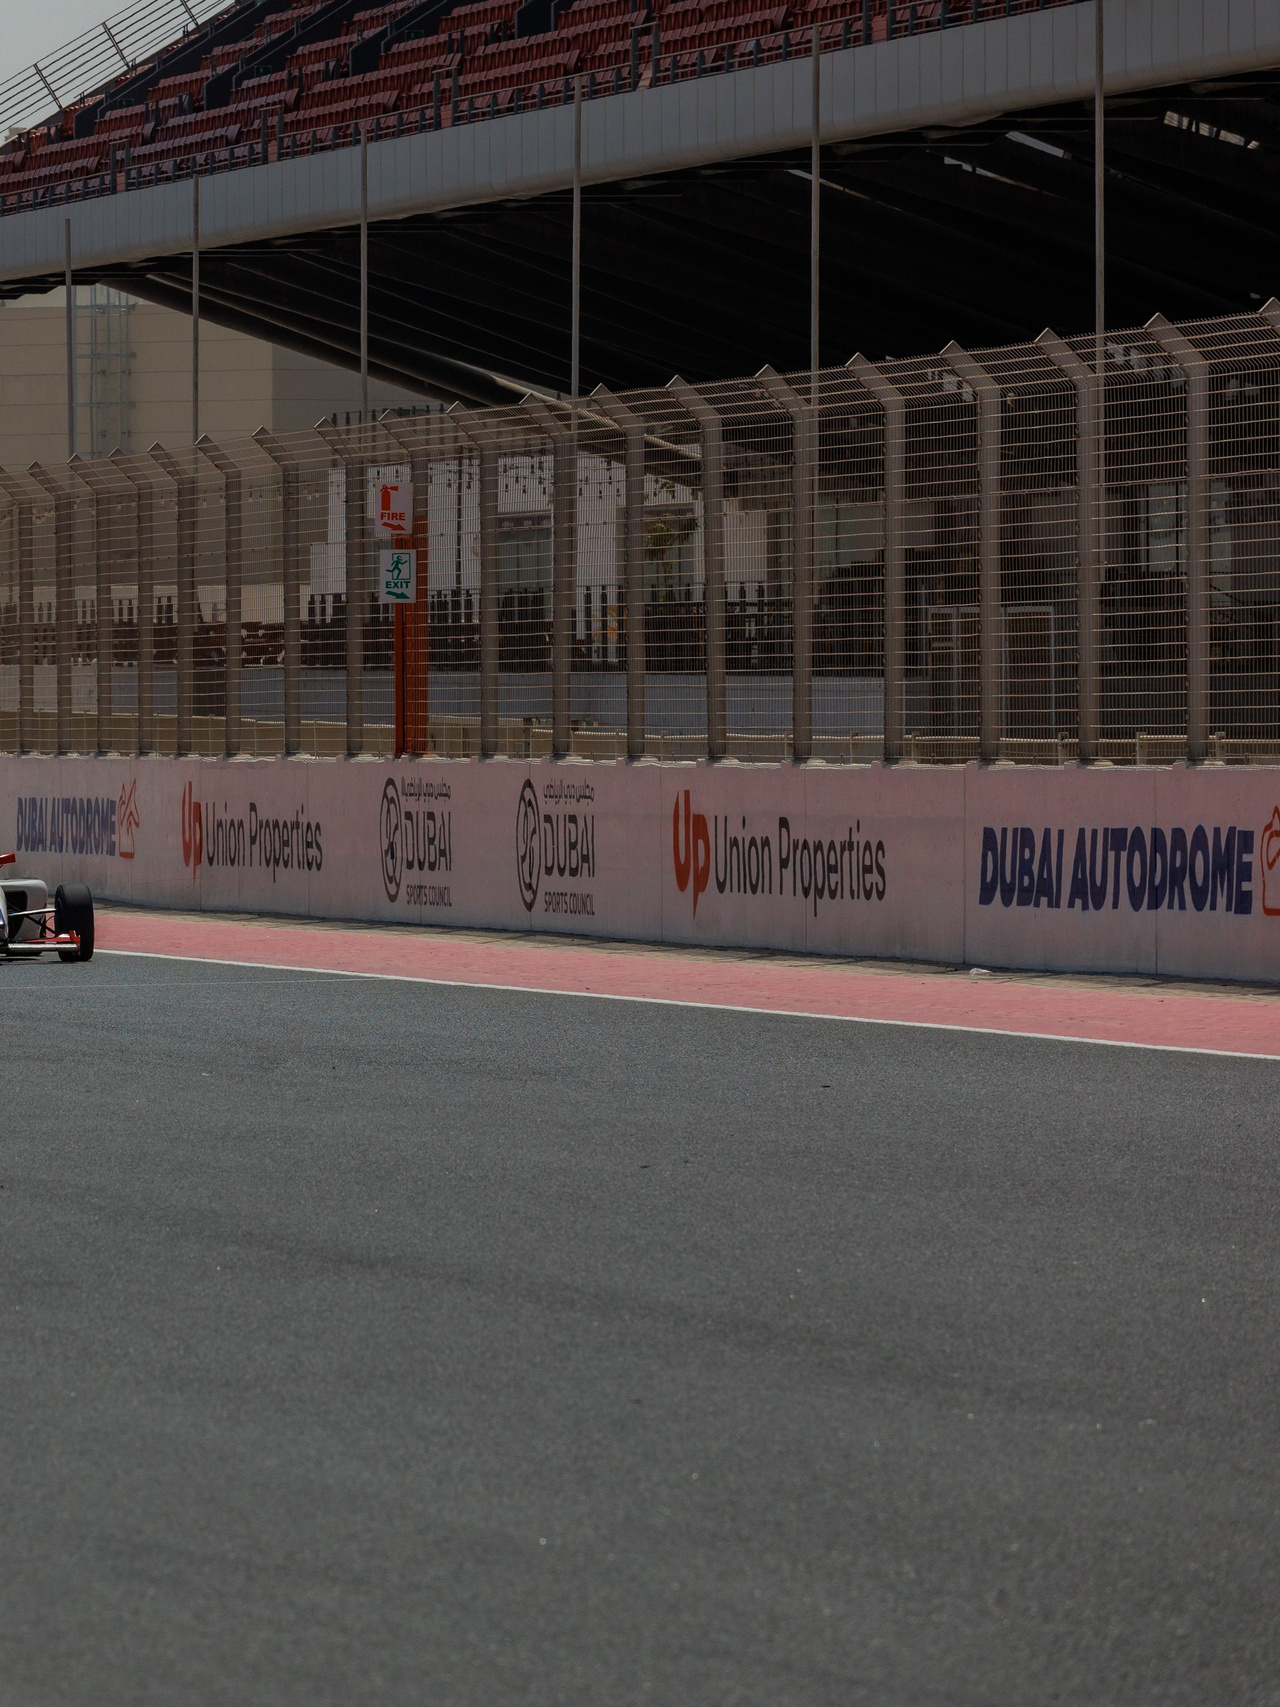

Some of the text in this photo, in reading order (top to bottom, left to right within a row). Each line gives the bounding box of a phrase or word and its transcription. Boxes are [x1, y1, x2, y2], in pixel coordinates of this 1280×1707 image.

[380, 512, 406, 521] FIRE
[385, 580, 411, 589] EXIT
[17, 797, 117, 857] DUBAI AUTODROME
[206, 801, 323, 883] Union Properties
[404, 811, 452, 872] DUBAI
[543, 814, 595, 878] DUBAI
[673, 789, 711, 921] Up
[406, 884, 452, 907] SPORTS COUNCIL
[714, 815, 887, 918] Union Properties
[979, 824, 1255, 915] DUBAI AUTODROME
[544, 891, 595, 916] SPORTS COUNCIL
